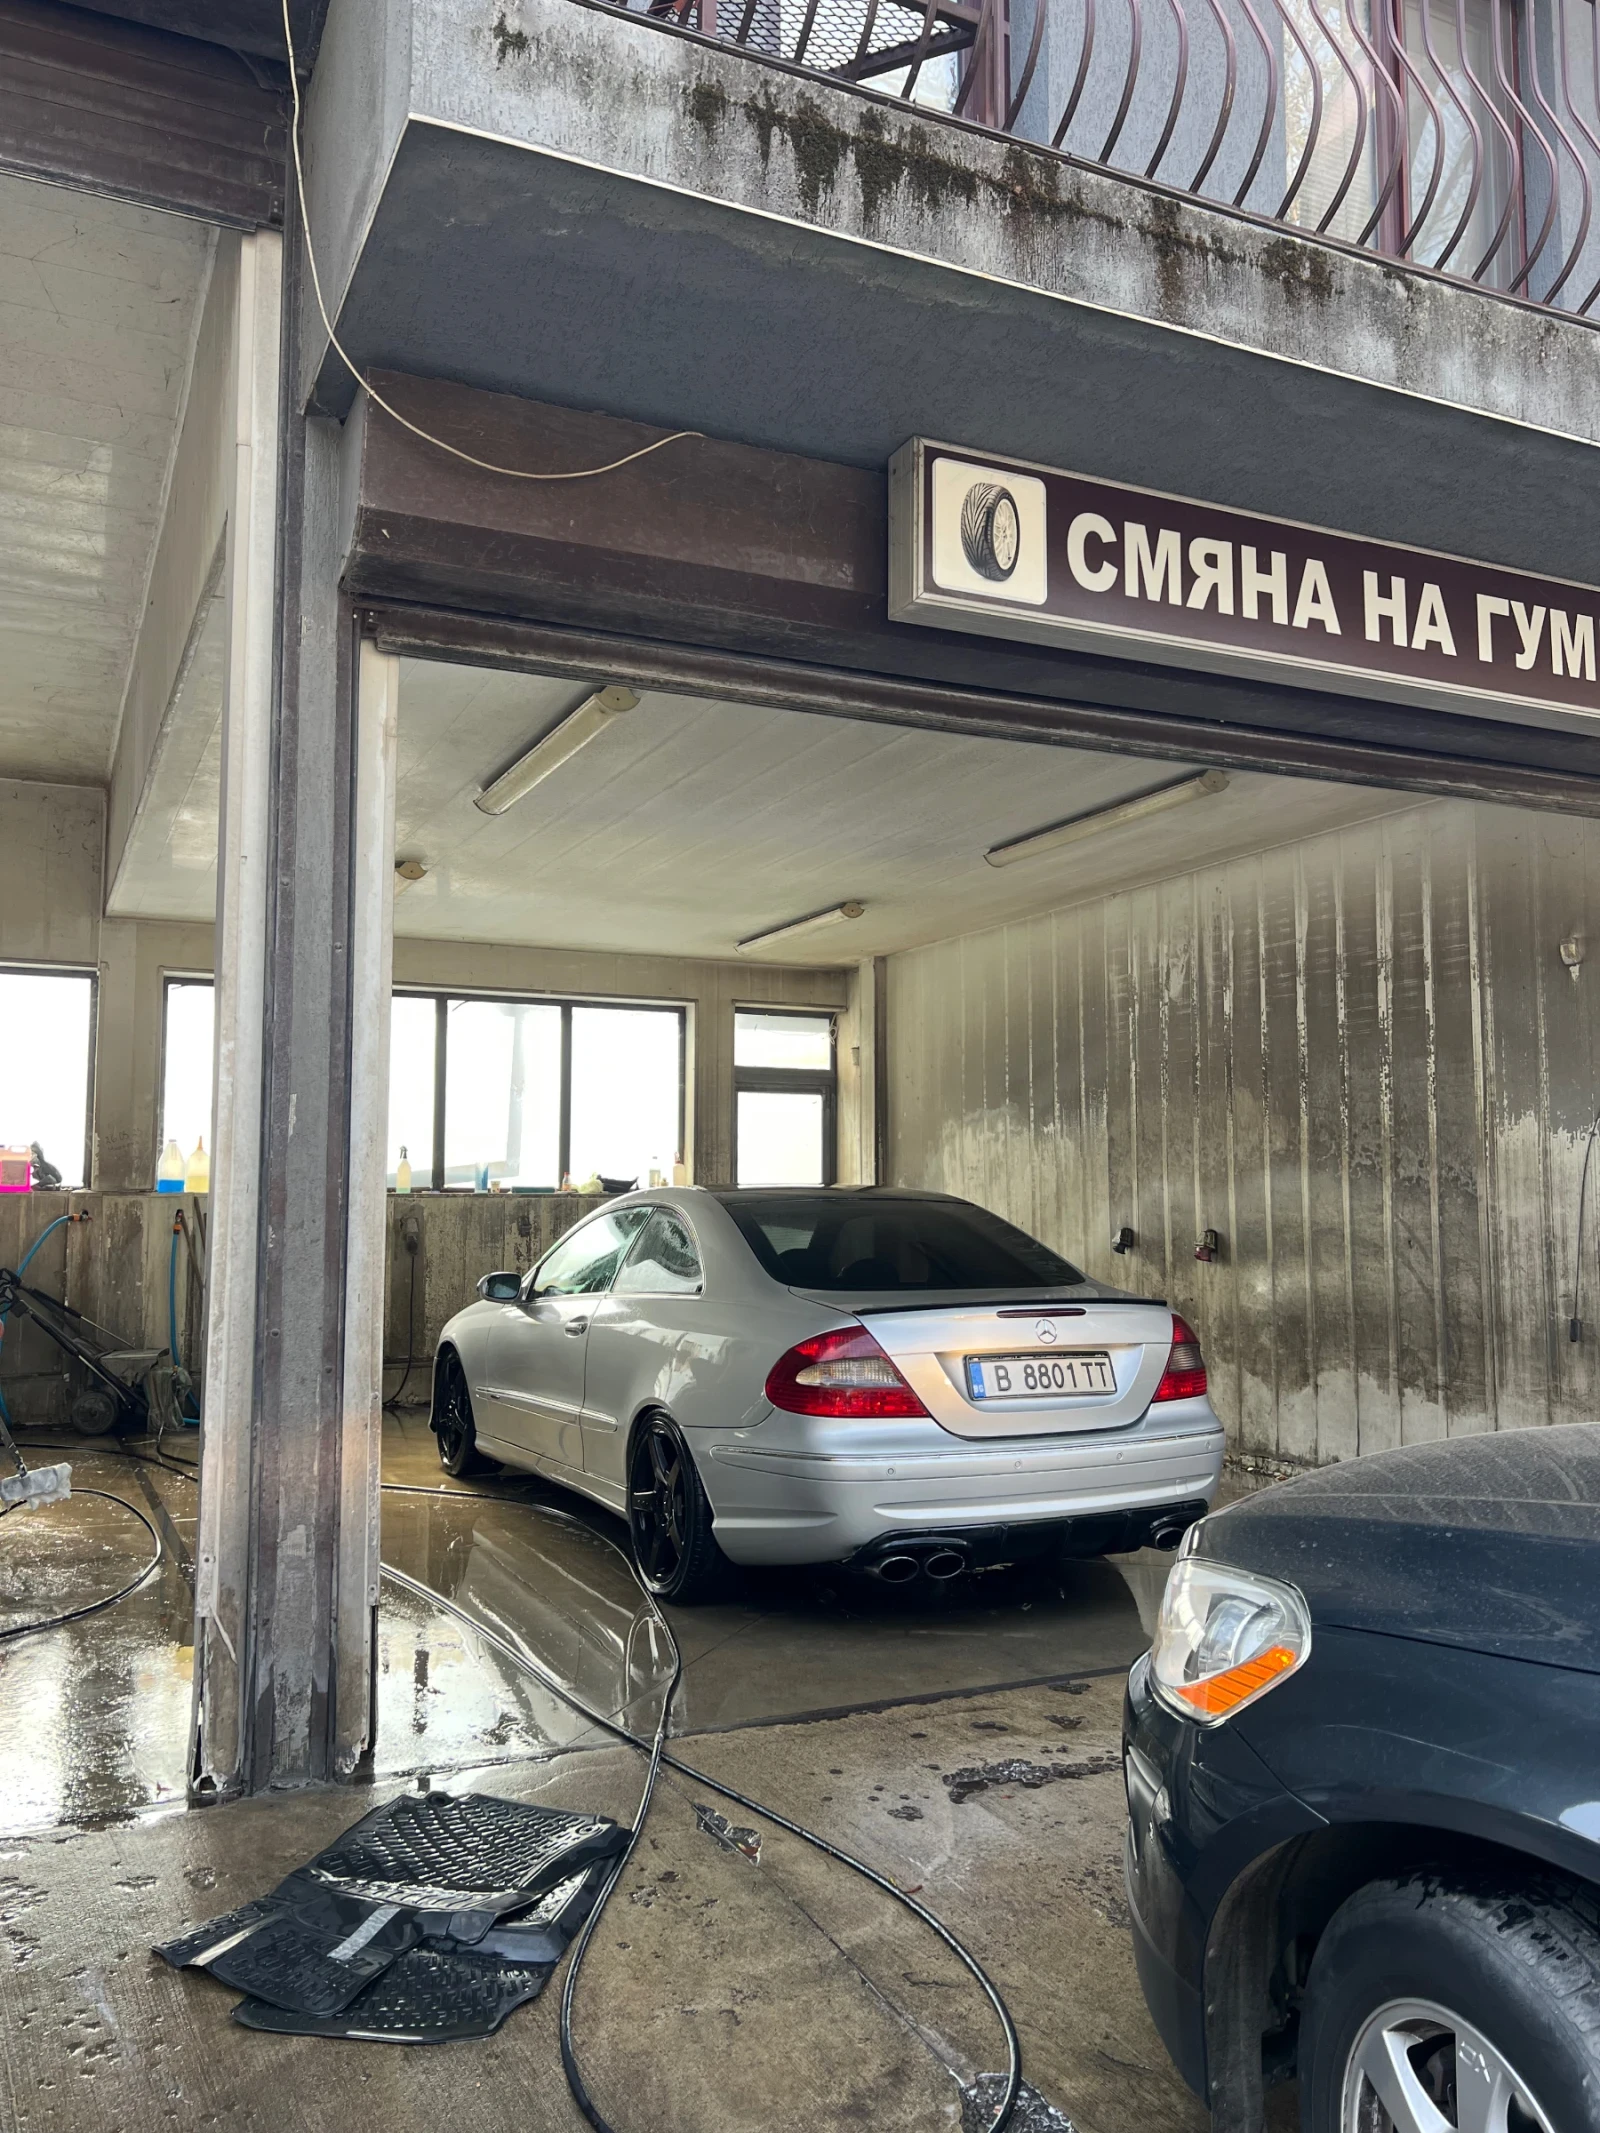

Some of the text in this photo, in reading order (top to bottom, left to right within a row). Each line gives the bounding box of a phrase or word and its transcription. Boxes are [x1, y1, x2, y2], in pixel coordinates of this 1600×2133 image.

[1066, 512, 1600, 682] СМЯНА НА ГУМ
[973, 1384, 985, 1394] BG
[994, 1365, 1012, 1392] B
